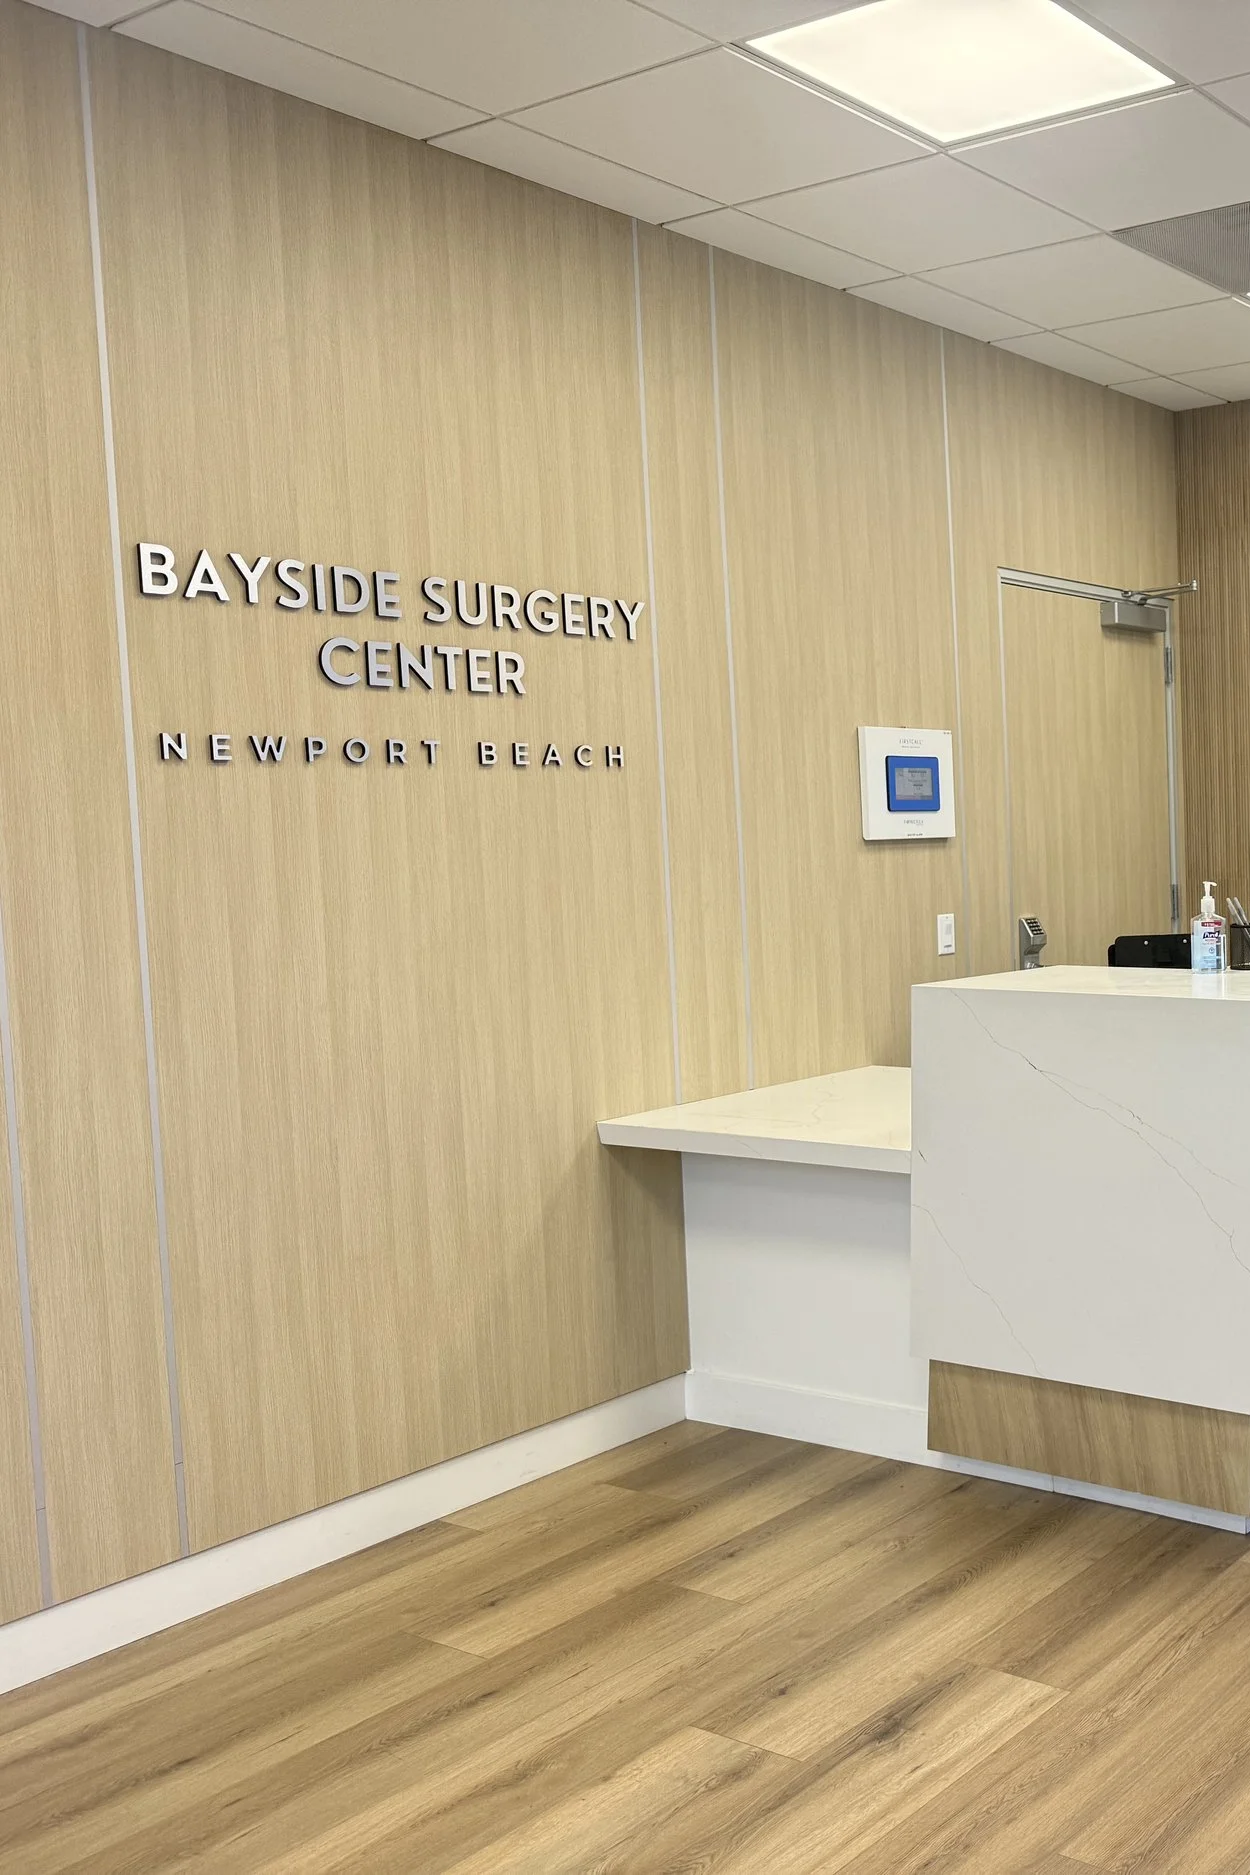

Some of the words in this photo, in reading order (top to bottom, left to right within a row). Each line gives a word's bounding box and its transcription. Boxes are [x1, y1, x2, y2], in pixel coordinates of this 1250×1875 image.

[136, 542, 403, 618] BAYSIDE
[421, 576, 646, 642] SURGERY
[319, 636, 526, 695] CENTER
[159, 732, 442, 765] NEWPORT
[478, 741, 625, 768] BEACH
